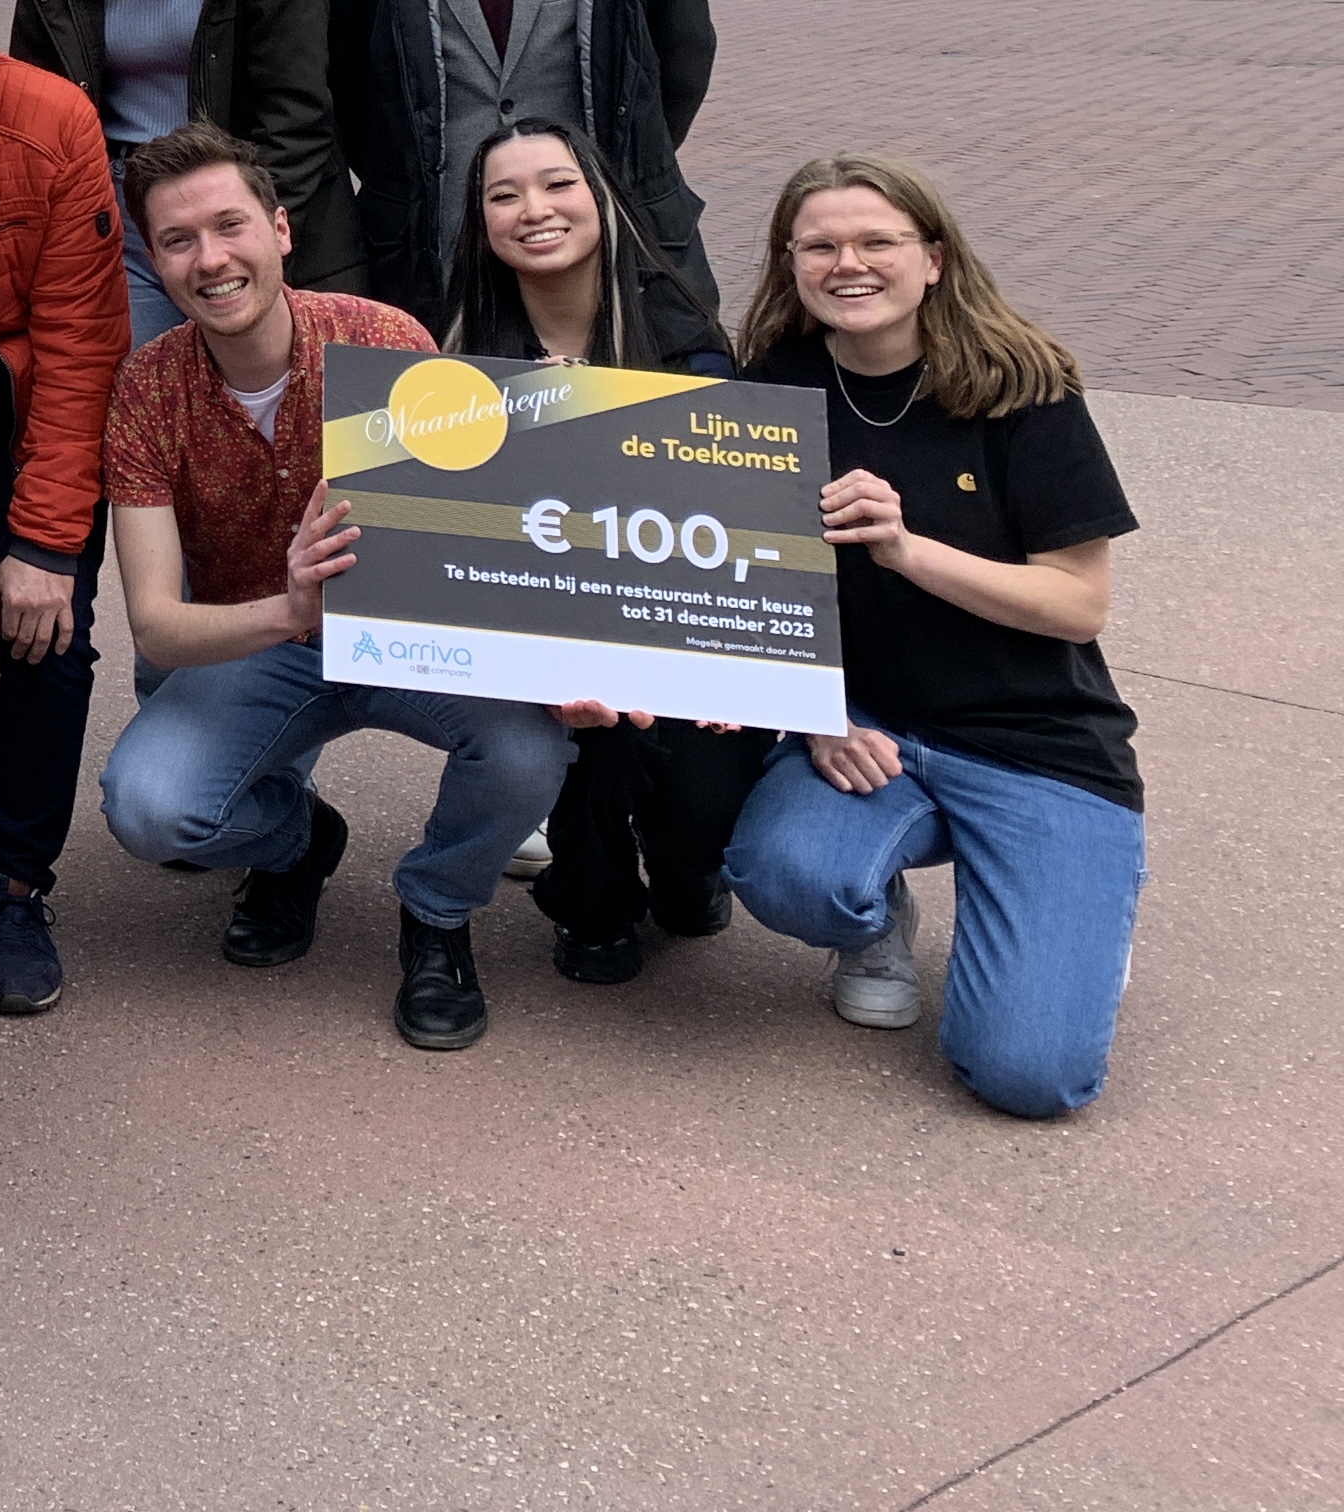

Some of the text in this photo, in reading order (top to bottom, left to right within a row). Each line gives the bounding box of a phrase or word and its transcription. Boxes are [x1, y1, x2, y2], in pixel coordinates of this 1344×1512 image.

[365, 381, 573, 448] Waardecheque
[690, 413, 799, 444] Lijn van
[621, 435, 801, 473] de Toekomst
[522, 499, 781, 581] € 100,-
[444, 563, 814, 618] Te besteden bij een restaurant naar keuze
[621, 604, 815, 639] tot 31 december 2023
[389, 640, 472, 666] arriva
[686, 637, 816, 660] Mogelijk gemaakt door Arriva
[431, 668, 472, 679] company
